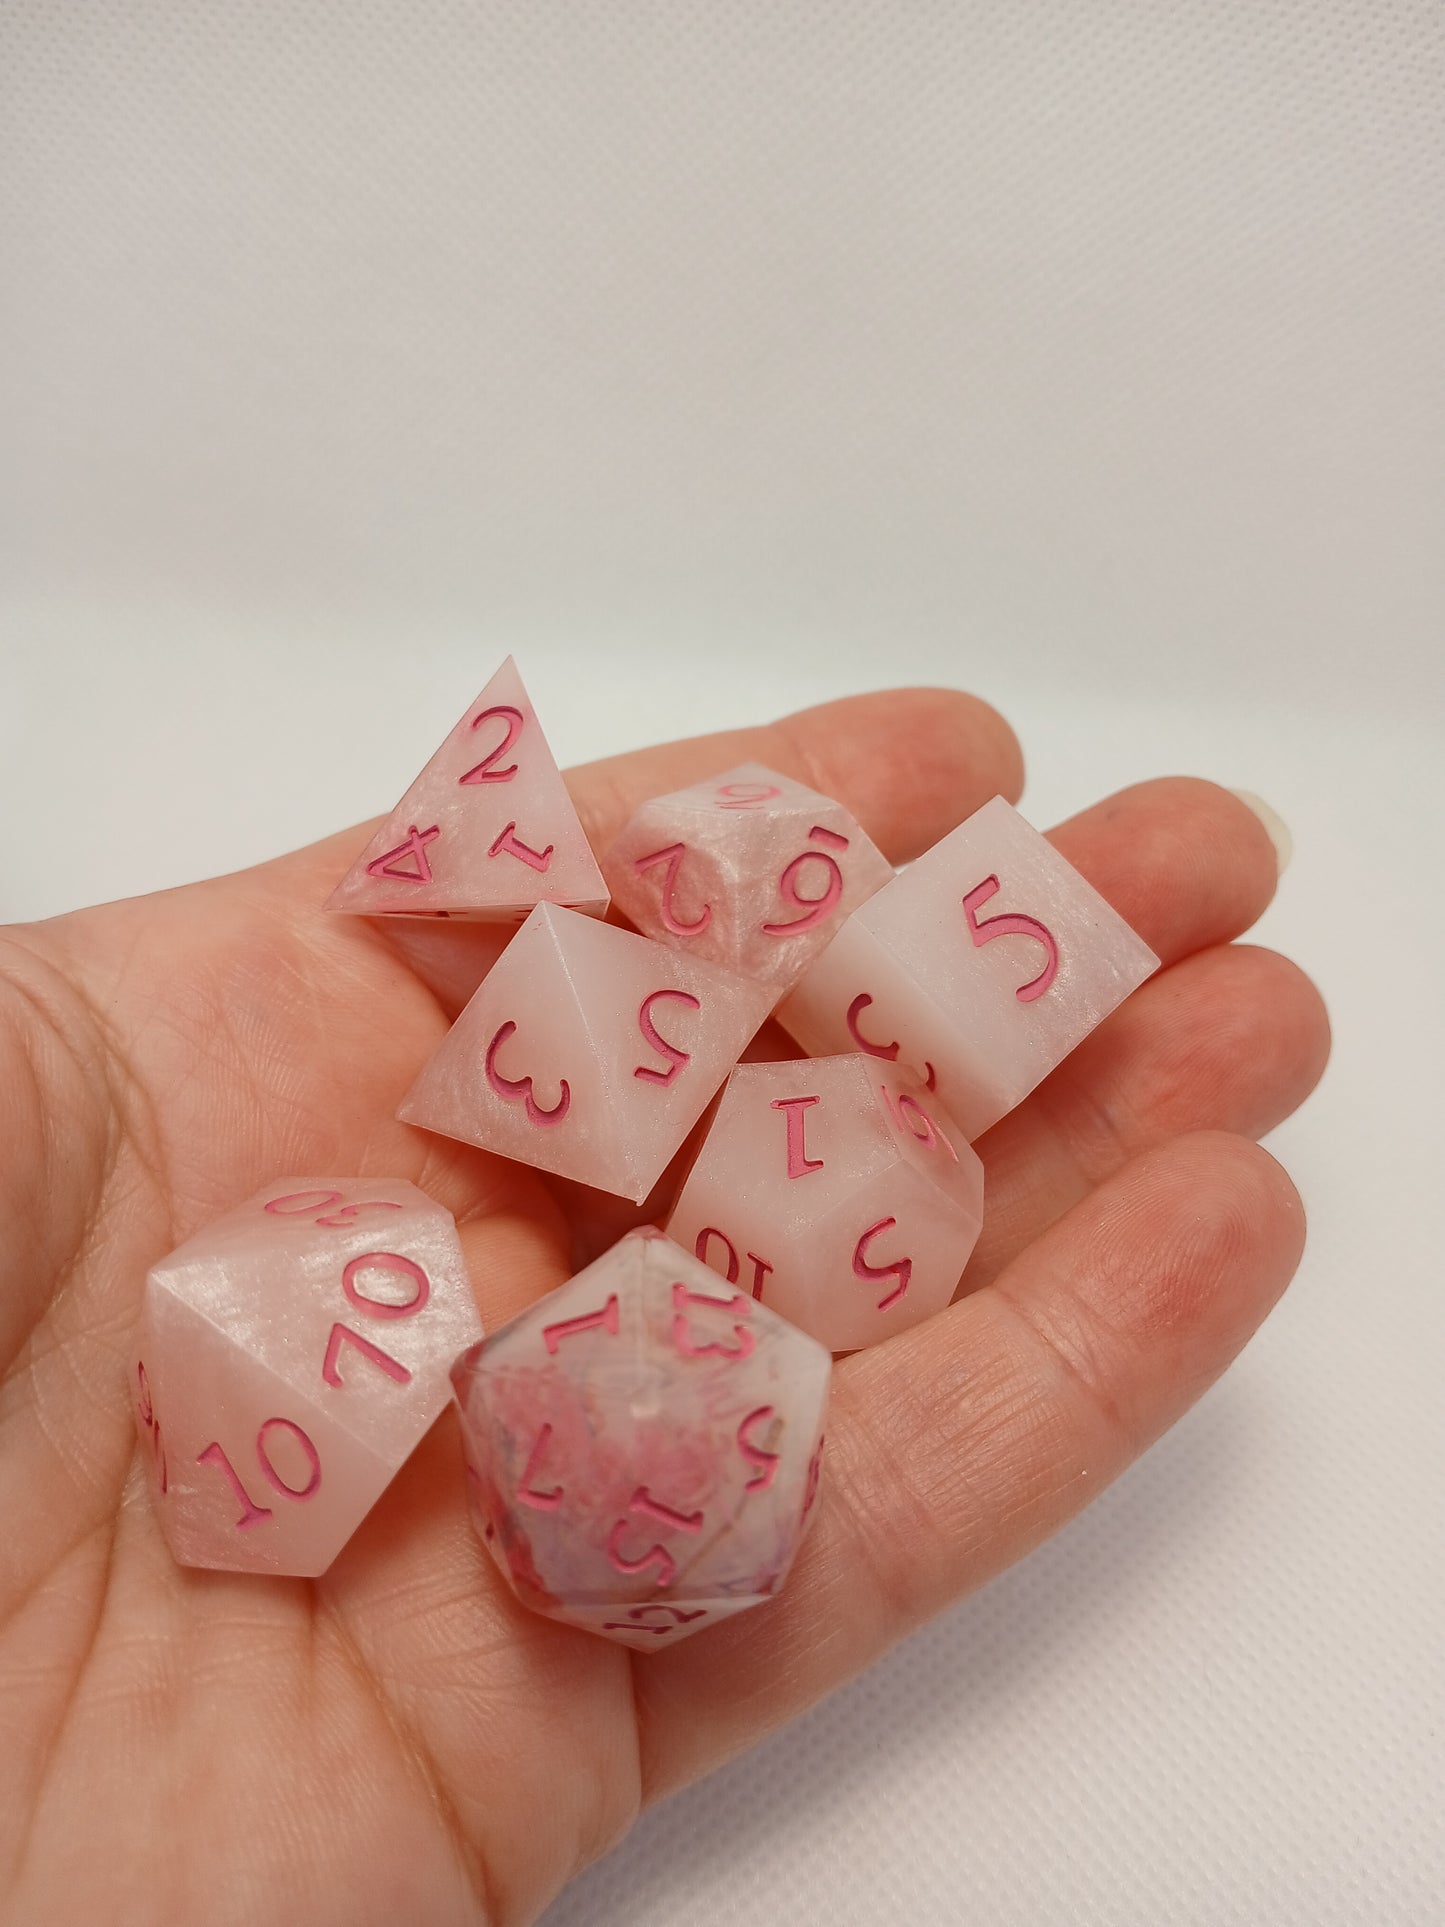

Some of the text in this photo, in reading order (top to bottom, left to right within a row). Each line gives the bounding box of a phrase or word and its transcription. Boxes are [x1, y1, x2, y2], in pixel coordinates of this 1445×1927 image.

[459, 705, 524, 785] 2
[365, 824, 440, 886] 4
[488, 821, 554, 874] 1
[634, 842, 712, 937] 2
[961, 873, 1060, 1003] 5
[485, 1020, 571, 1128] 3
[633, 988, 701, 1088] 5
[770, 1094, 825, 1180] 1
[264, 1189, 404, 1229] 30
[852, 1216, 913, 1313] 5
[321, 1251, 431, 1389] 70
[542, 1292, 619, 1356] 1
[672, 1281, 755, 1360] 13
[195, 1416, 322, 1531] 10
[517, 1421, 564, 1512] 7
[737, 1404, 781, 1493] 5
[607, 1485, 704, 1587] 15
[602, 1604, 707, 1635] 12
